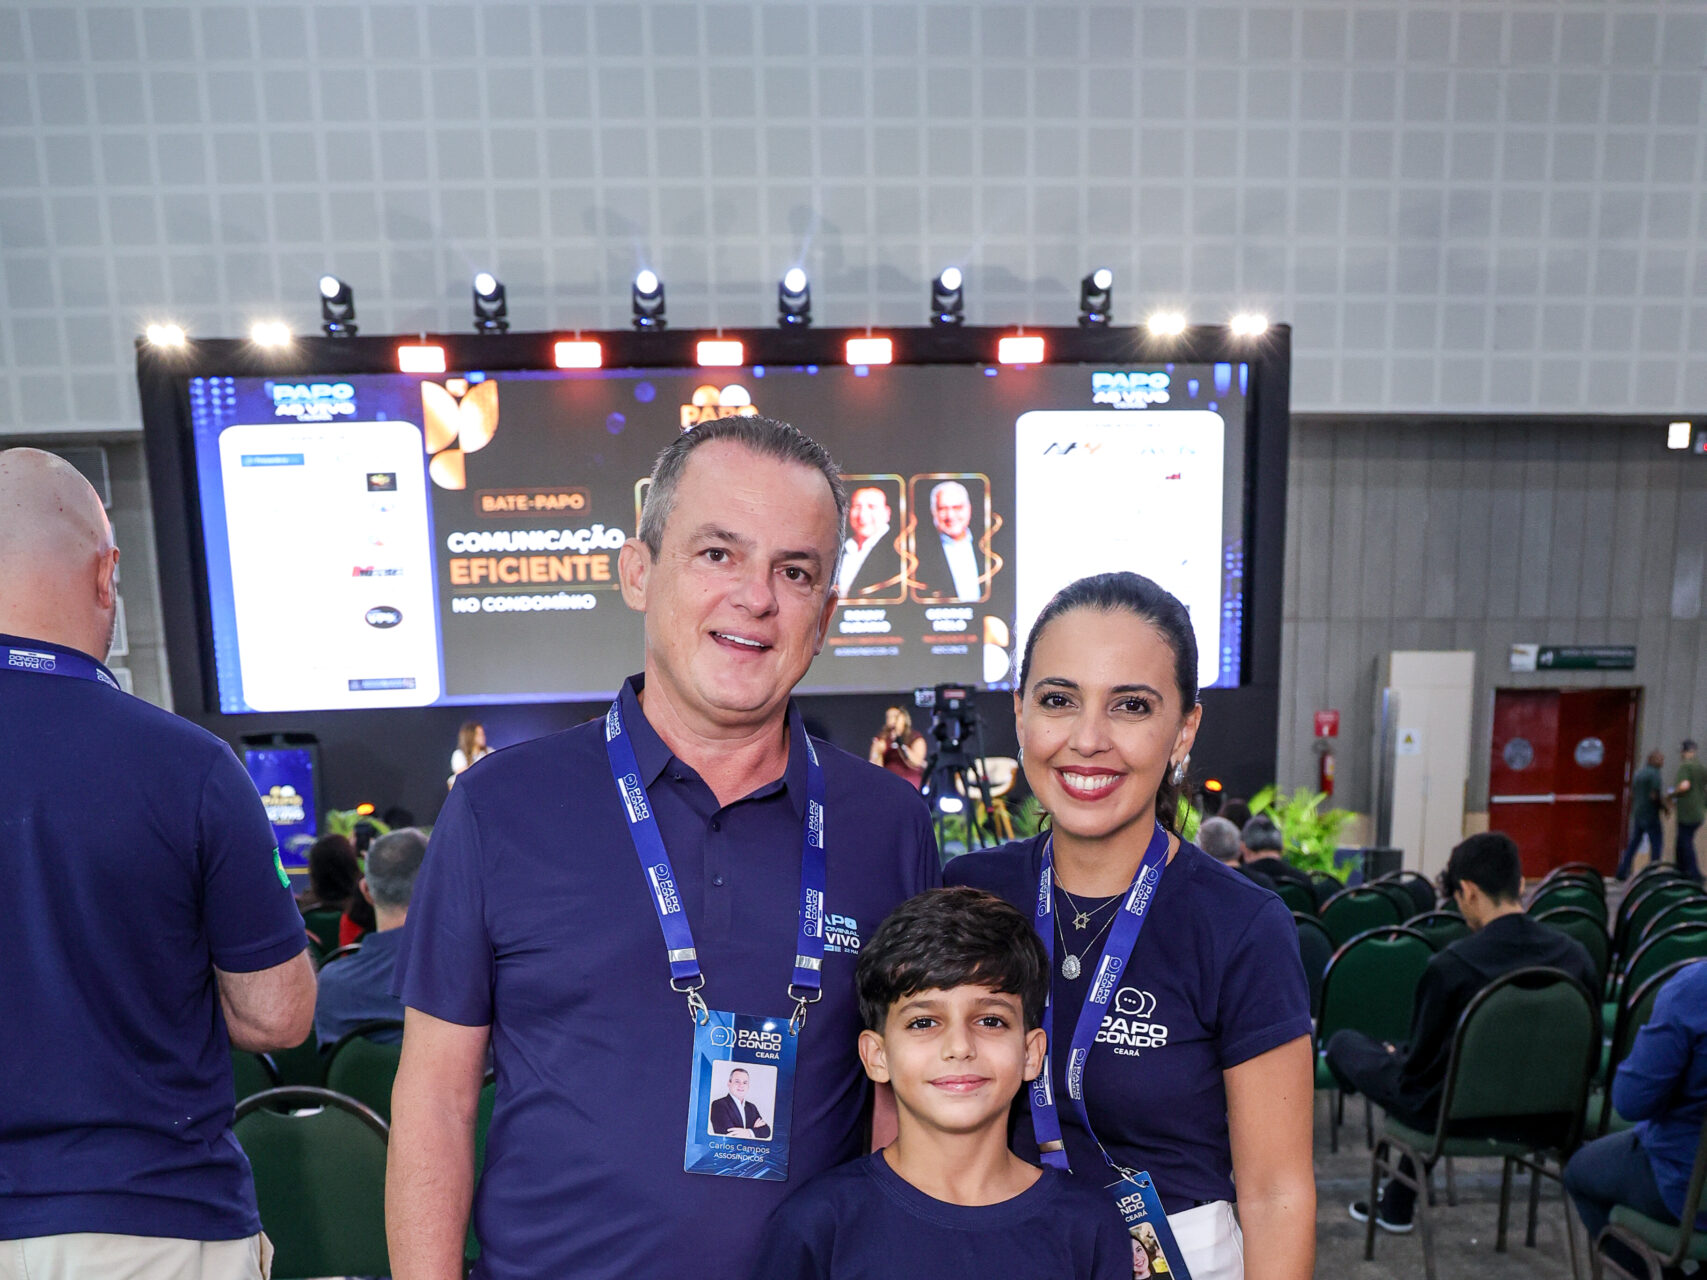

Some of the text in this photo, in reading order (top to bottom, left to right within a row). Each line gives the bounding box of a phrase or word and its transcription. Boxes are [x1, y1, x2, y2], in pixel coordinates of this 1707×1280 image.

[1092, 371, 1170, 390] PAPO
[273, 383, 355, 401] PAPO
[481, 493, 585, 512] BATE-PAPO
[447, 524, 626, 554] COMUNICAÇÃO
[450, 554, 611, 585] EFICIENTE
[452, 592, 597, 613] NO CONDOMÍNIO
[8, 659, 39, 669] PAPO
[613, 711, 621, 736] PAPO
[629, 790, 644, 821] CONDO
[633, 787, 650, 819] PAPO
[660, 881, 674, 914] CONDO
[665, 880, 681, 913] PAPO
[805, 888, 813, 919] PAPO
[1131, 883, 1147, 914] CONDO
[1136, 885, 1153, 916] PAPO
[825, 932, 861, 949] VIVO
[1095, 972, 1110, 1004] CONDO
[1100, 972, 1117, 1005] PAPO
[738, 1029, 782, 1043] PAPO
[738, 1040, 782, 1051] CONDO
[1094, 1030, 1167, 1048] CONDO
[755, 1051, 780, 1060] CEARÁ
[1113, 1047, 1140, 1057] CEARÁ
[708, 1141, 771, 1154] Carlos Campos
[1120, 1201, 1145, 1216] NDO
[1125, 1208, 1148, 1222] CEARÁ
